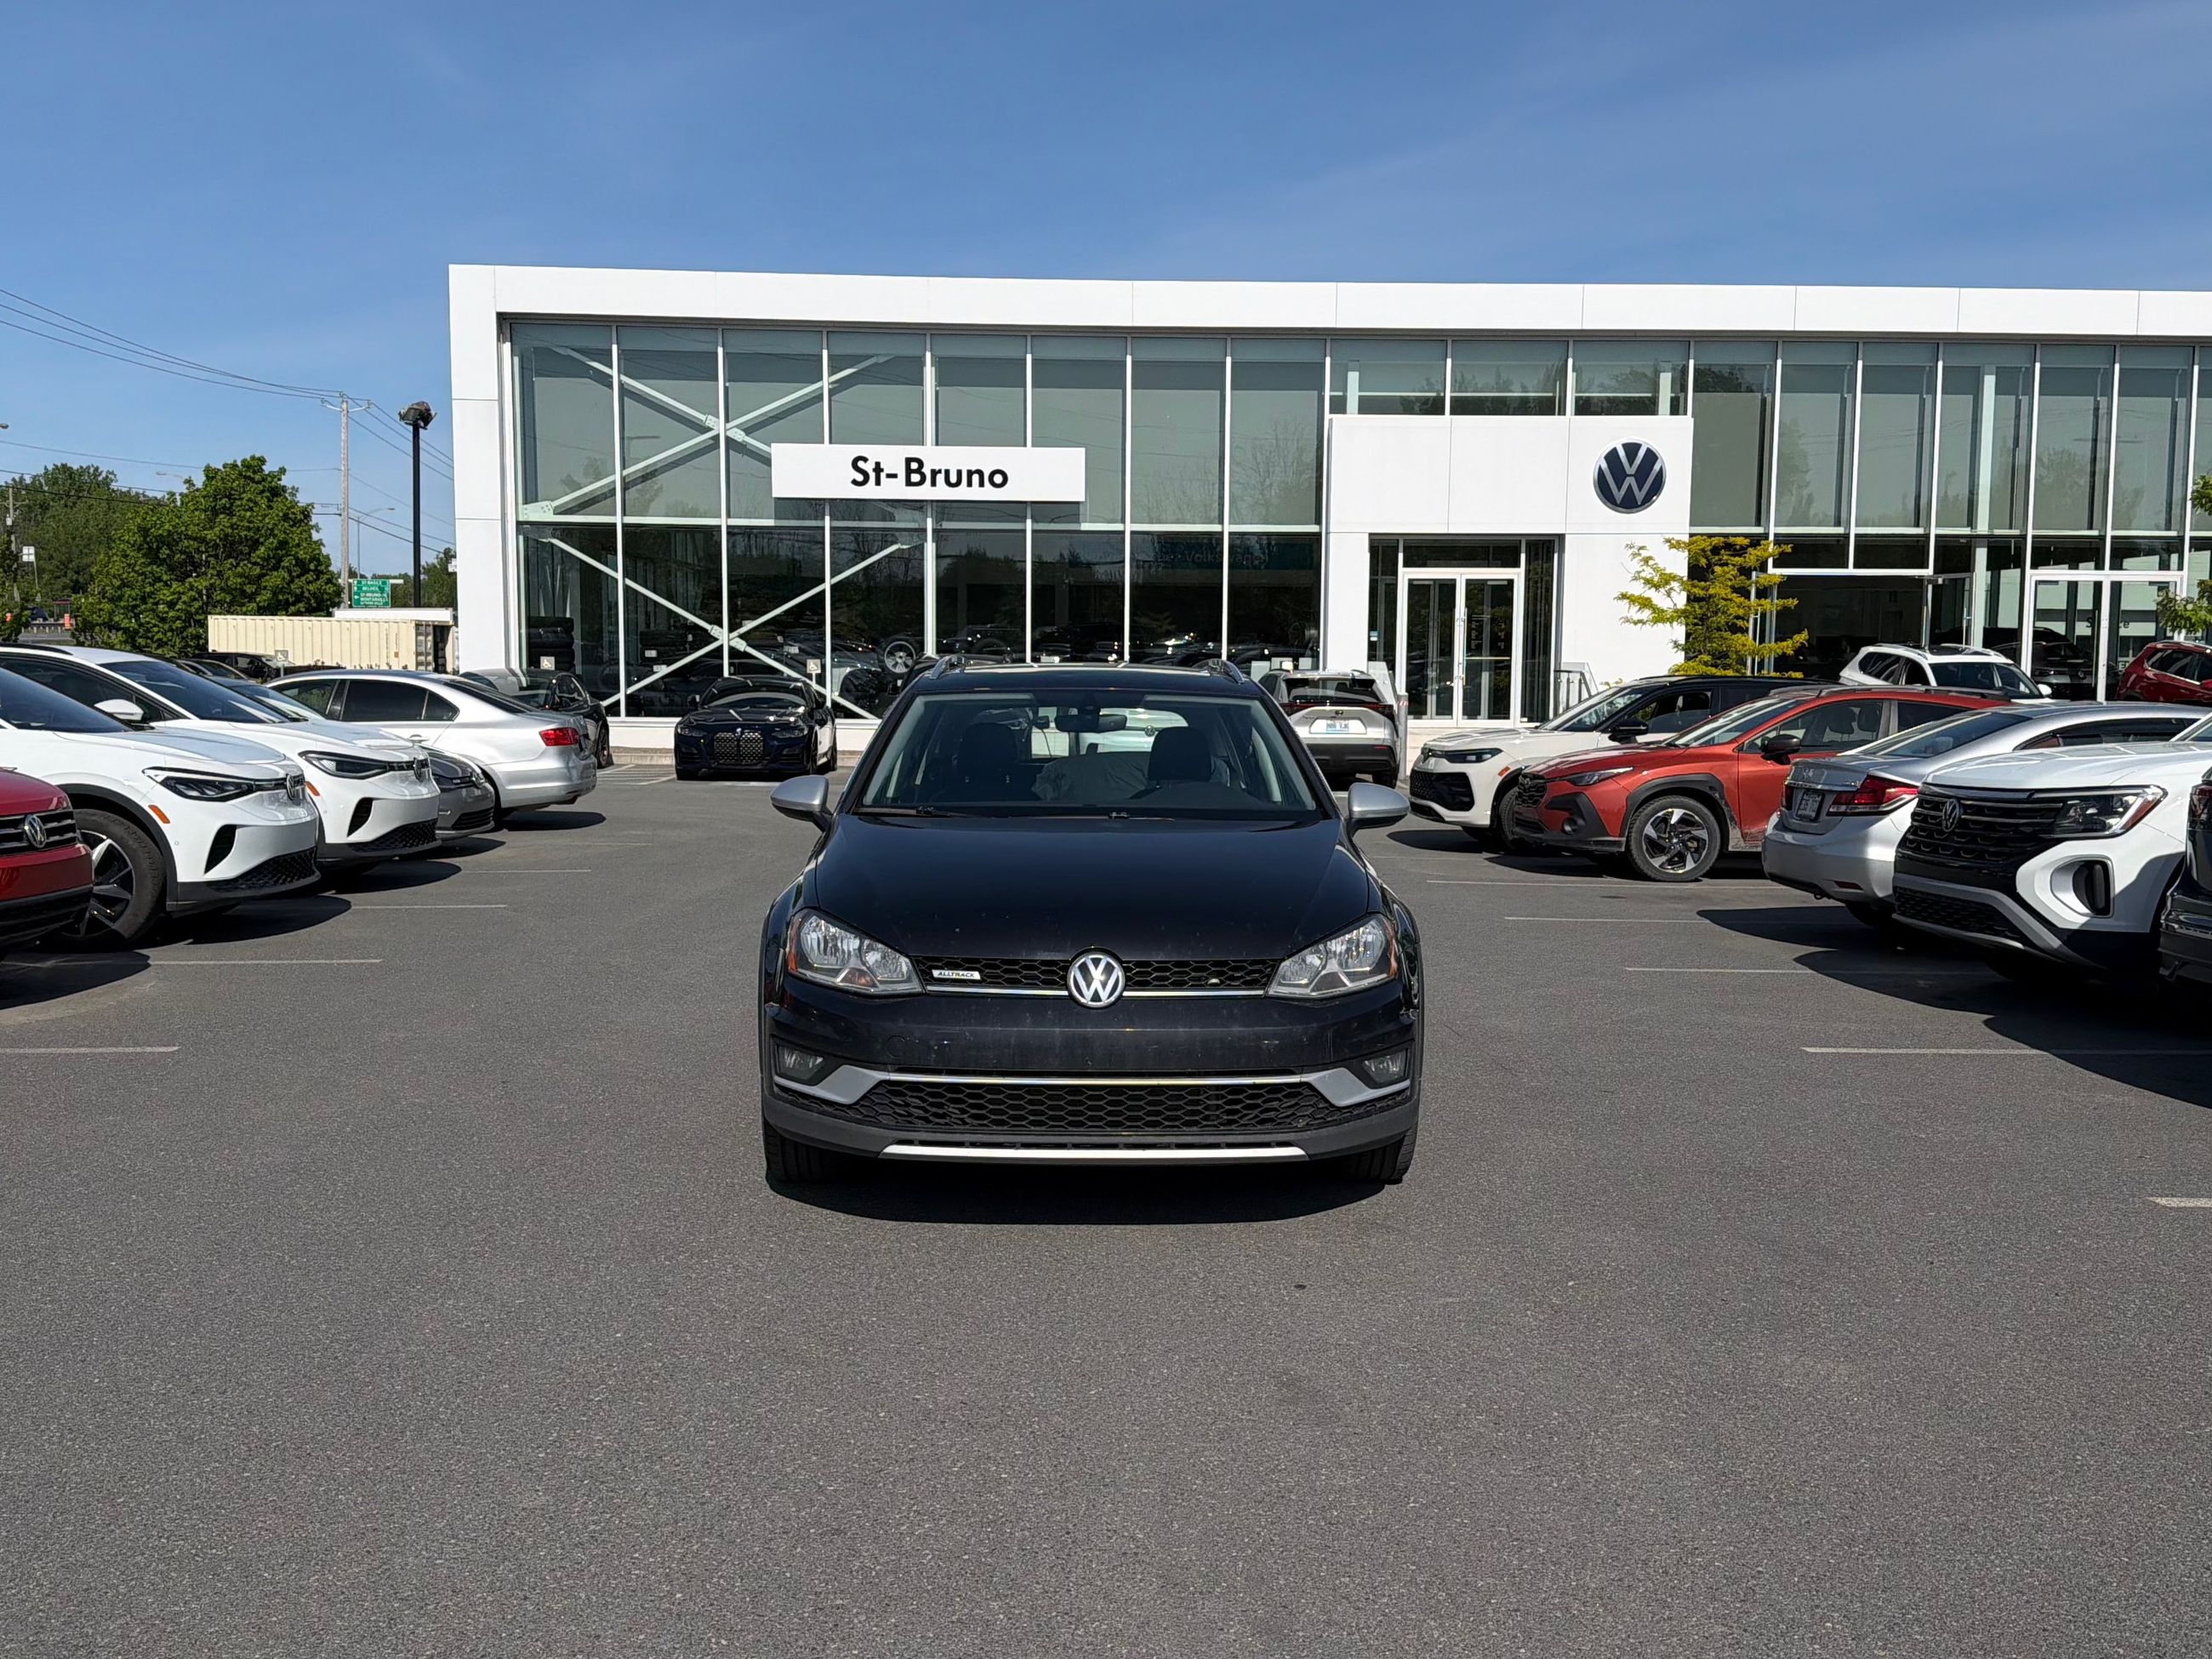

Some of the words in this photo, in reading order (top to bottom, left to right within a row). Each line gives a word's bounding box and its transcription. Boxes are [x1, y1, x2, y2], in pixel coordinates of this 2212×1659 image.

[851, 455, 1008, 488] St-Bruno
[1595, 439, 1664, 510] VW
[1069, 954, 1122, 1005] VW
